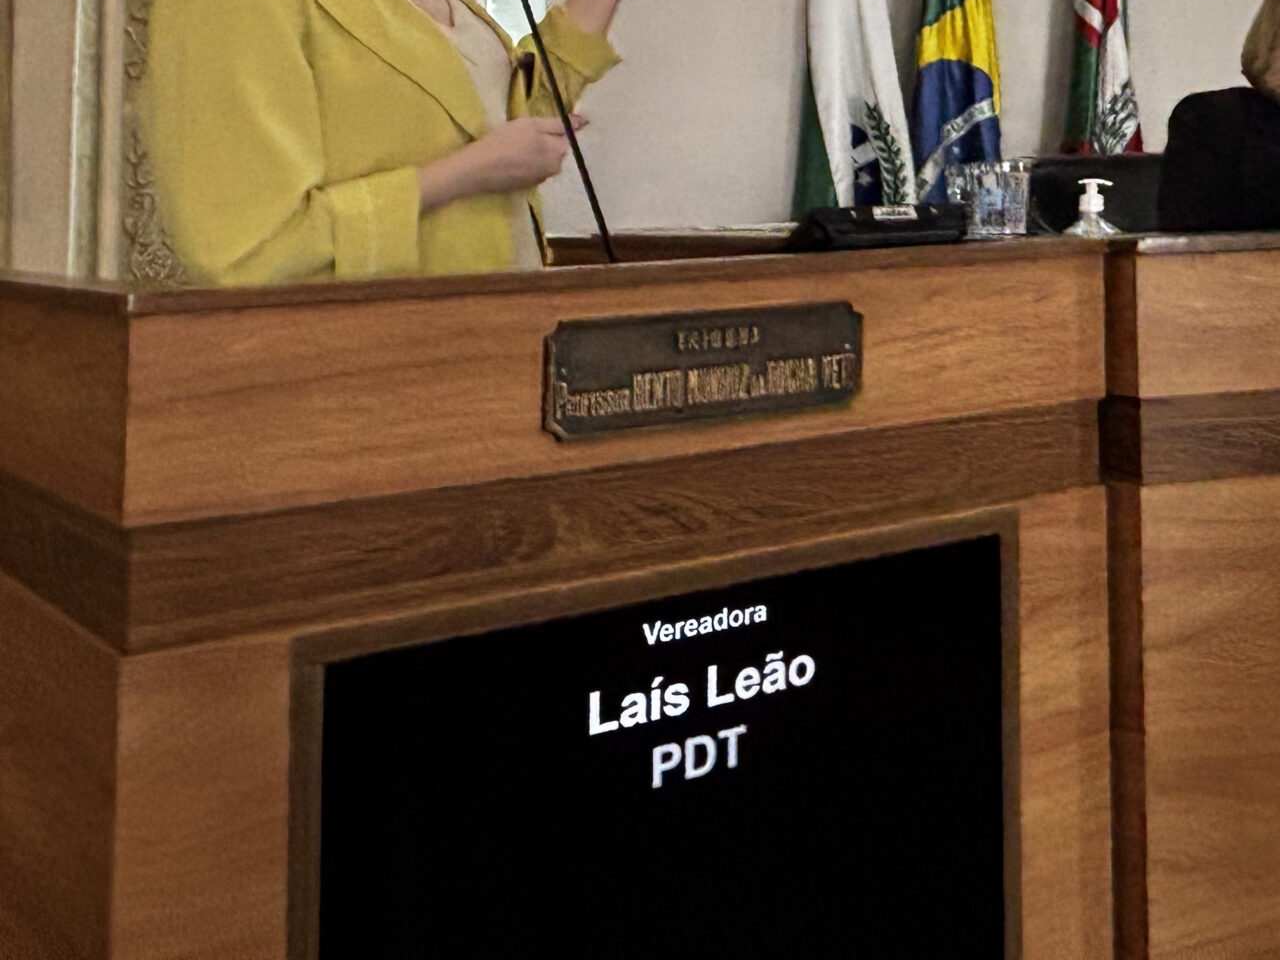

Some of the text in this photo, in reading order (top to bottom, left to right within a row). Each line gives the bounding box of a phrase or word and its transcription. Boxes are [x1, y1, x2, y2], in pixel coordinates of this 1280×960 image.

[643, 605, 767, 645] Vereadora
[589, 651, 816, 736] Laís Leão
[652, 724, 748, 789] PDT
